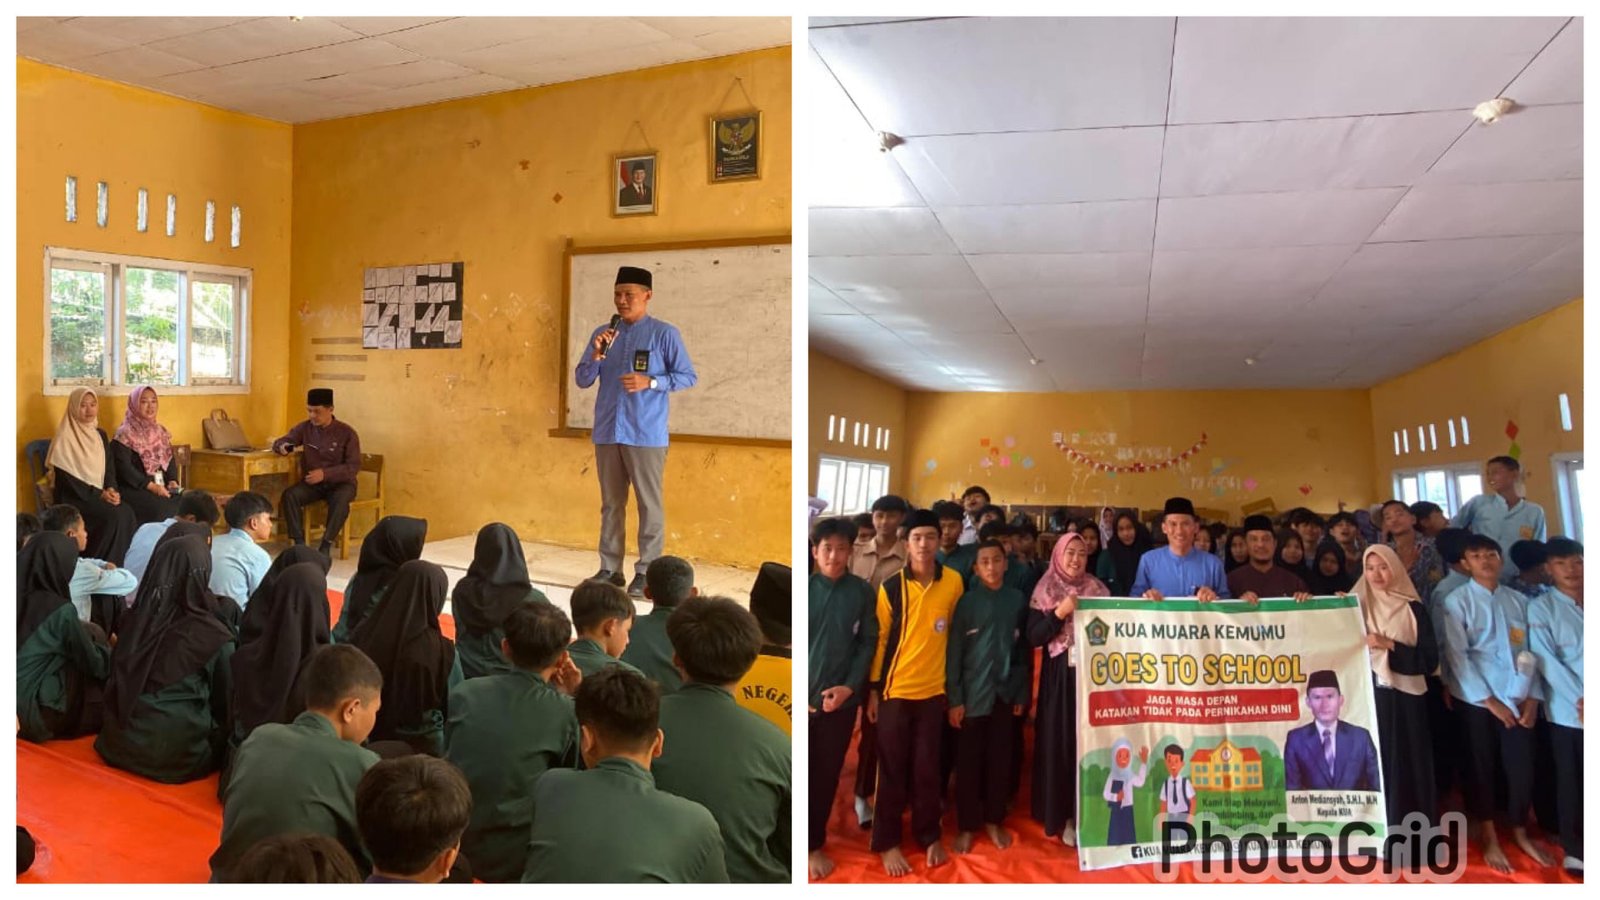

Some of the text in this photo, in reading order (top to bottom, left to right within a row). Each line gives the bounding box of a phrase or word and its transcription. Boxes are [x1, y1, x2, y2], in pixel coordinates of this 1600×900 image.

[1114, 622, 1286, 641] KUA MUARA KEMUMU
[1090, 651, 1307, 685] GOES TO SCHOOL
[1145, 694, 1238, 706] JAGA MASA DEPAN
[1094, 704, 1292, 719] KATAKAN TIDAK PADA PERNIKAHAN DINI
[1317, 807, 1337, 818] Kepala
[1143, 845, 1162, 857] KUA
